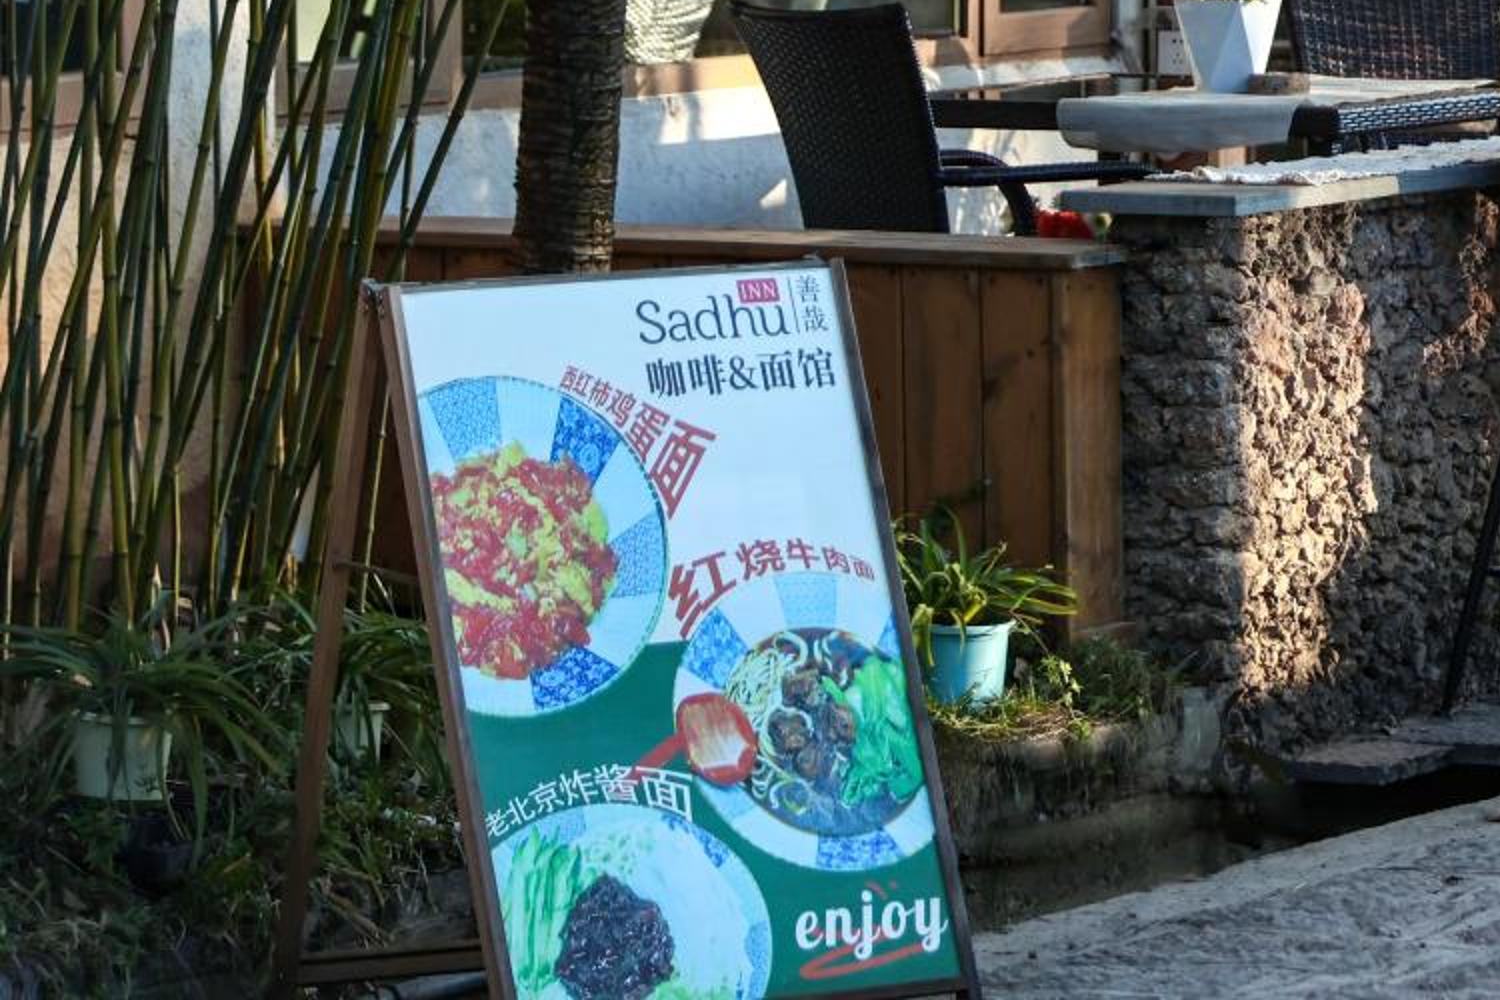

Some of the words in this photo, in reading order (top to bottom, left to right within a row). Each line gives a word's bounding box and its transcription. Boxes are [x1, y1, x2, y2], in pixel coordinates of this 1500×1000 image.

[636, 294, 791, 344] Sadhu
[739, 281, 777, 299] INN
[646, 348, 835, 397] 咖啡&面馆
[560, 365, 716, 519] 西红柿鸡蛋面
[668, 538, 875, 639] 红烧牛肉面
[485, 763, 693, 836] 老北京炸酱面
[796, 890, 948, 960] enjoy
